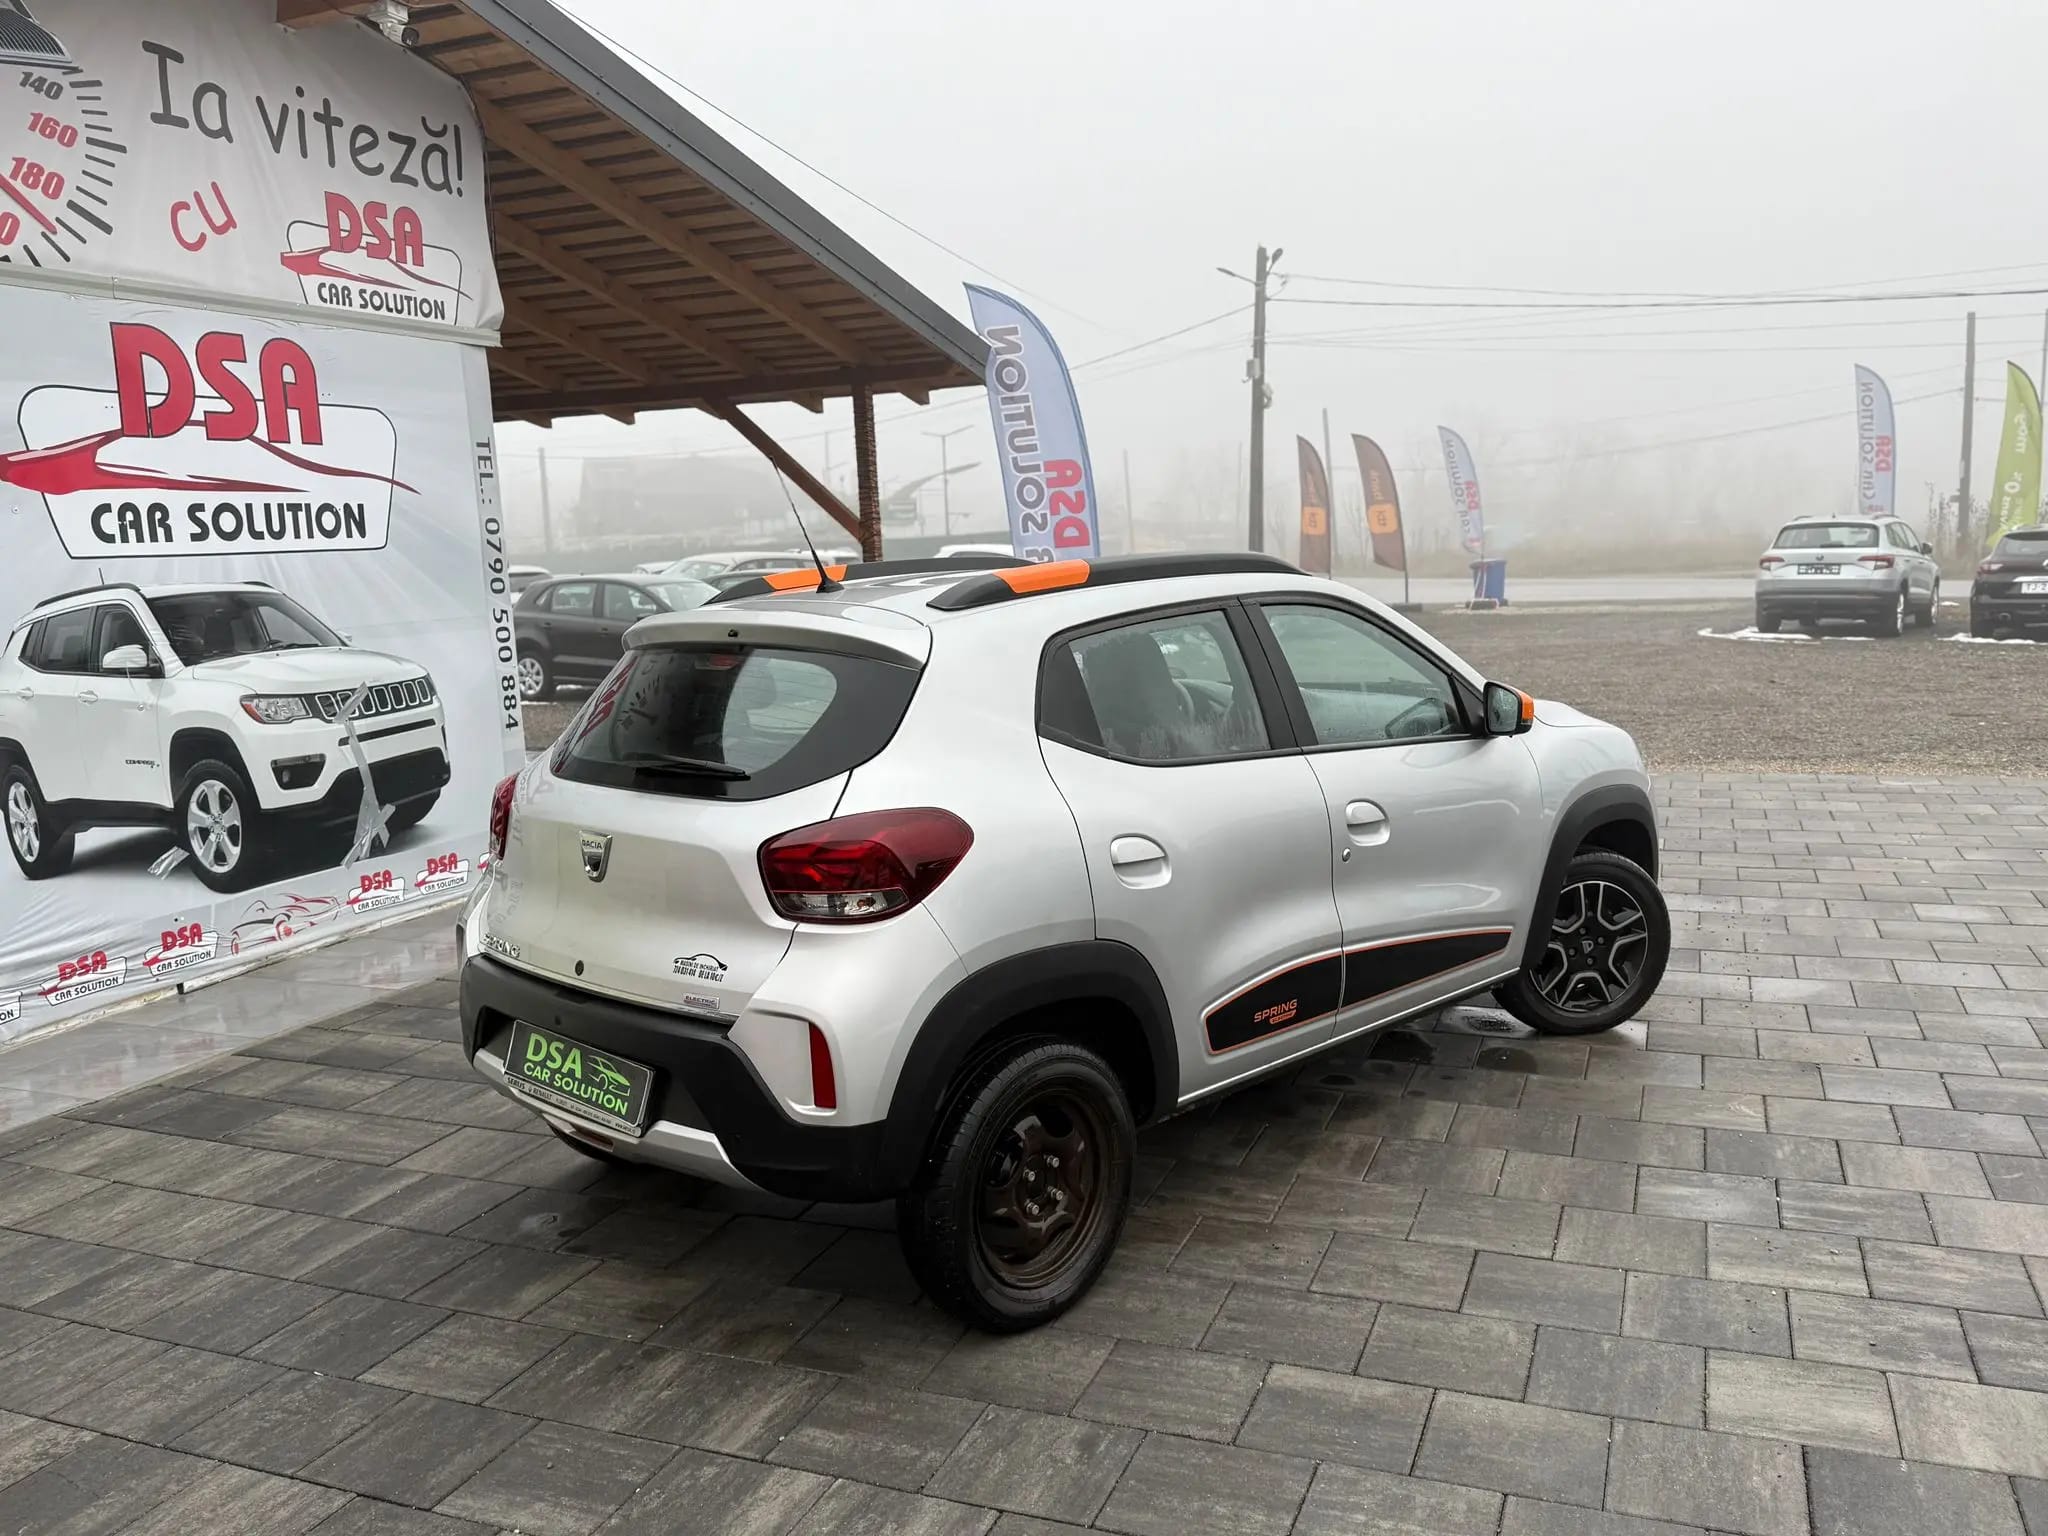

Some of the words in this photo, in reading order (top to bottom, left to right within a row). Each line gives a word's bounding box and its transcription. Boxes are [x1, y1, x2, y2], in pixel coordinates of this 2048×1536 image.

[19, 71, 64, 100] 140
[27, 112, 79, 148] 160
[141, 40, 234, 144] Ia
[255, 86, 465, 198] viteză!
[8, 156, 66, 200] 180
[170, 181, 237, 252] cu
[324, 191, 424, 267] DSA
[317, 283, 353, 307] CAR
[359, 289, 446, 320] SOLUTION
[110, 321, 323, 446] DSA
[90, 502, 173, 544] CAR
[188, 502, 367, 542] SOLUTION
[484, 517, 506, 594] 0790
[493, 607, 513, 663] 500
[501, 674, 519, 731] 884
[360, 869, 393, 893] DSA
[427, 853, 458, 875] DSA
[437, 876, 465, 889] SOLUTION
[357, 902, 370, 911] CAR
[370, 894, 400, 907] SOLUTION
[161, 923, 203, 951] DSA
[58, 950, 107, 981] DSA
[156, 962, 172, 973] CAR
[174, 950, 211, 969] SOLUTION
[54, 990, 72, 1002] CAR
[74, 976, 119, 996] SOLUTION
[1254, 998, 1298, 1023] SPRING
[526, 1032, 582, 1079] DSA
[524, 1062, 550, 1083] CAR
[553, 1074, 628, 1116] SOLUTION
